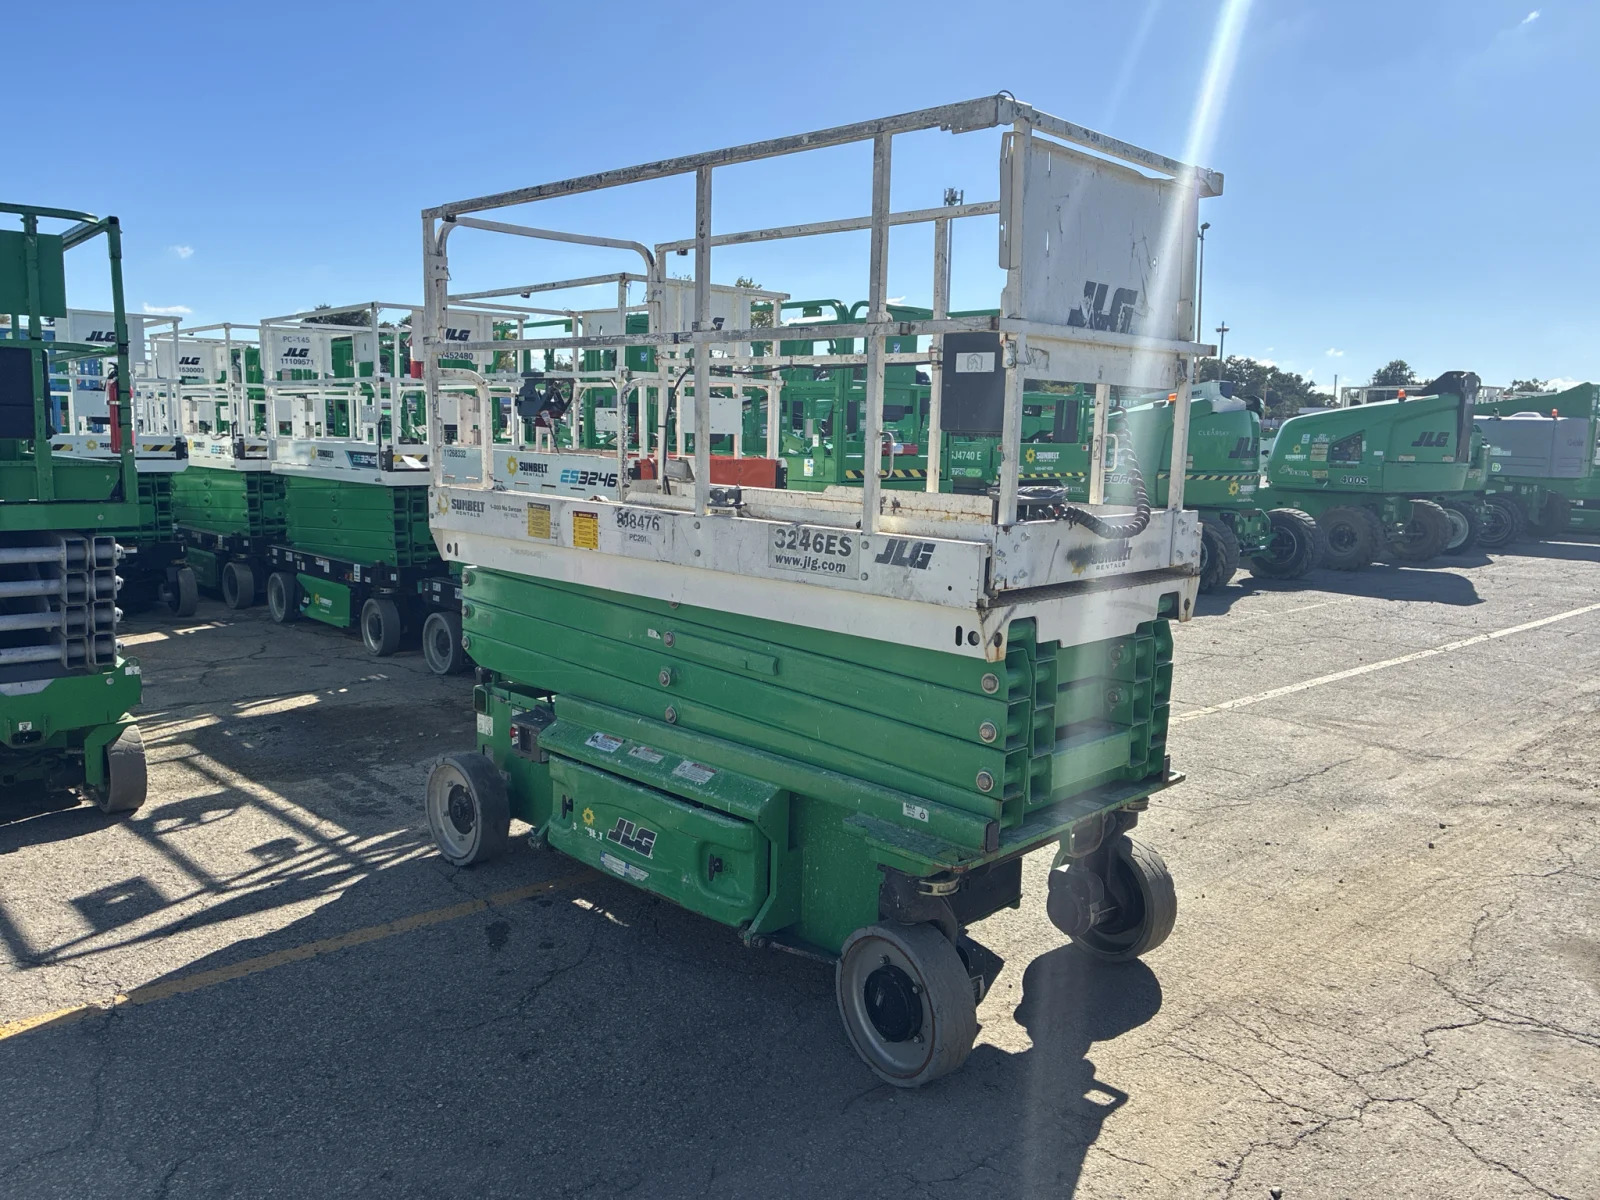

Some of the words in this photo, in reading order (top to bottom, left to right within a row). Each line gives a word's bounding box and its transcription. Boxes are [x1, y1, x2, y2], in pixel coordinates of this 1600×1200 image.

[1067, 281, 1138, 334] JLG
[85, 331, 116, 342] JLG
[283, 347, 310, 358] JLG
[179, 356, 201, 365] JLG
[280, 358, 314, 366] 11109571
[1411, 431, 1450, 448] JLG
[518, 461, 548, 474] SUNBELT
[560, 469, 618, 488] ES3246
[451, 498, 485, 513] SUNBELT
[456, 510, 481, 518] RENTALS
[774, 528, 852, 557] 3246ES
[875, 539, 936, 570] JLG
[775, 554, 847, 574] www.jlg.com
[1096, 561, 1126, 570] RENTALS
[606, 817, 658, 858] JLG
